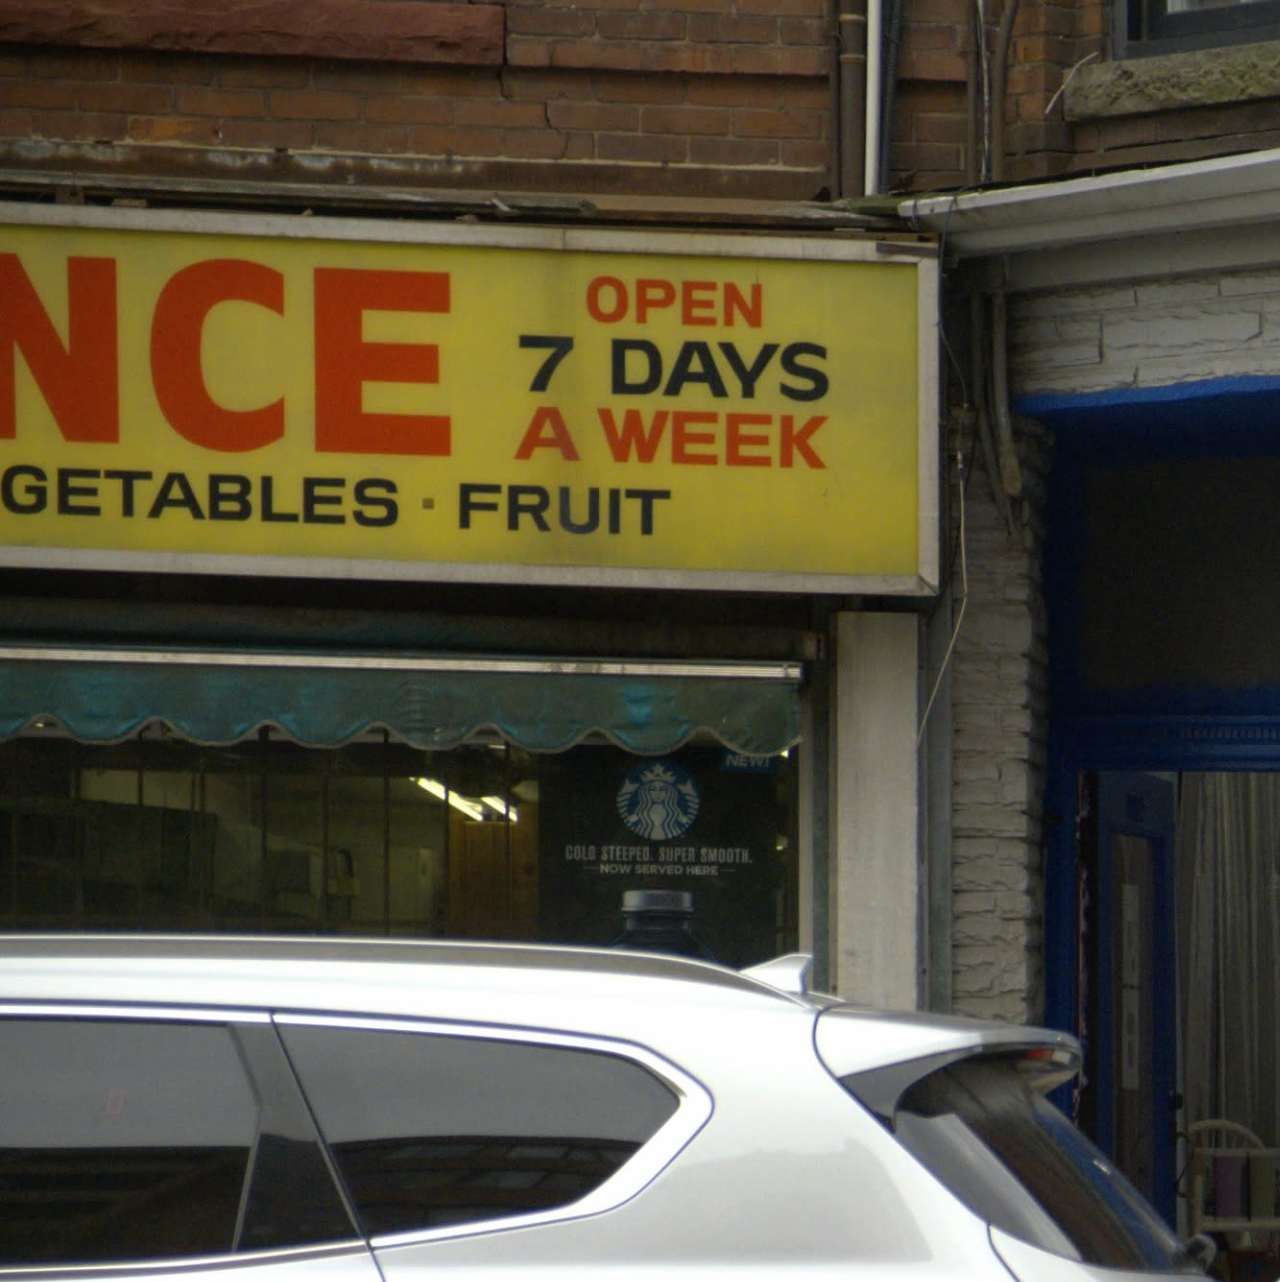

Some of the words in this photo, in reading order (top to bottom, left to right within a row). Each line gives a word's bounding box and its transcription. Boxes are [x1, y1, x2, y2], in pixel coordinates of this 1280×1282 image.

[586, 276, 763, 328] OPEN
[0, 252, 453, 458] NCE
[518, 334, 575, 394] 7
[611, 338, 830, 403] DAYS
[514, 406, 580, 462] A
[598, 408, 828, 470] WEEK
[0, 464, 400, 529] GETABLES
[458, 482, 672, 537] FRUIT
[564, 844, 597, 862] COLD
[600, 845, 653, 863] STEEPED.
[658, 846, 696, 863] SUPER
[699, 847, 753, 864] SMOOTH.
[599, 864, 632, 875] NOW
[634, 864, 683, 876] SERVED
[685, 865, 720, 876] HERE
